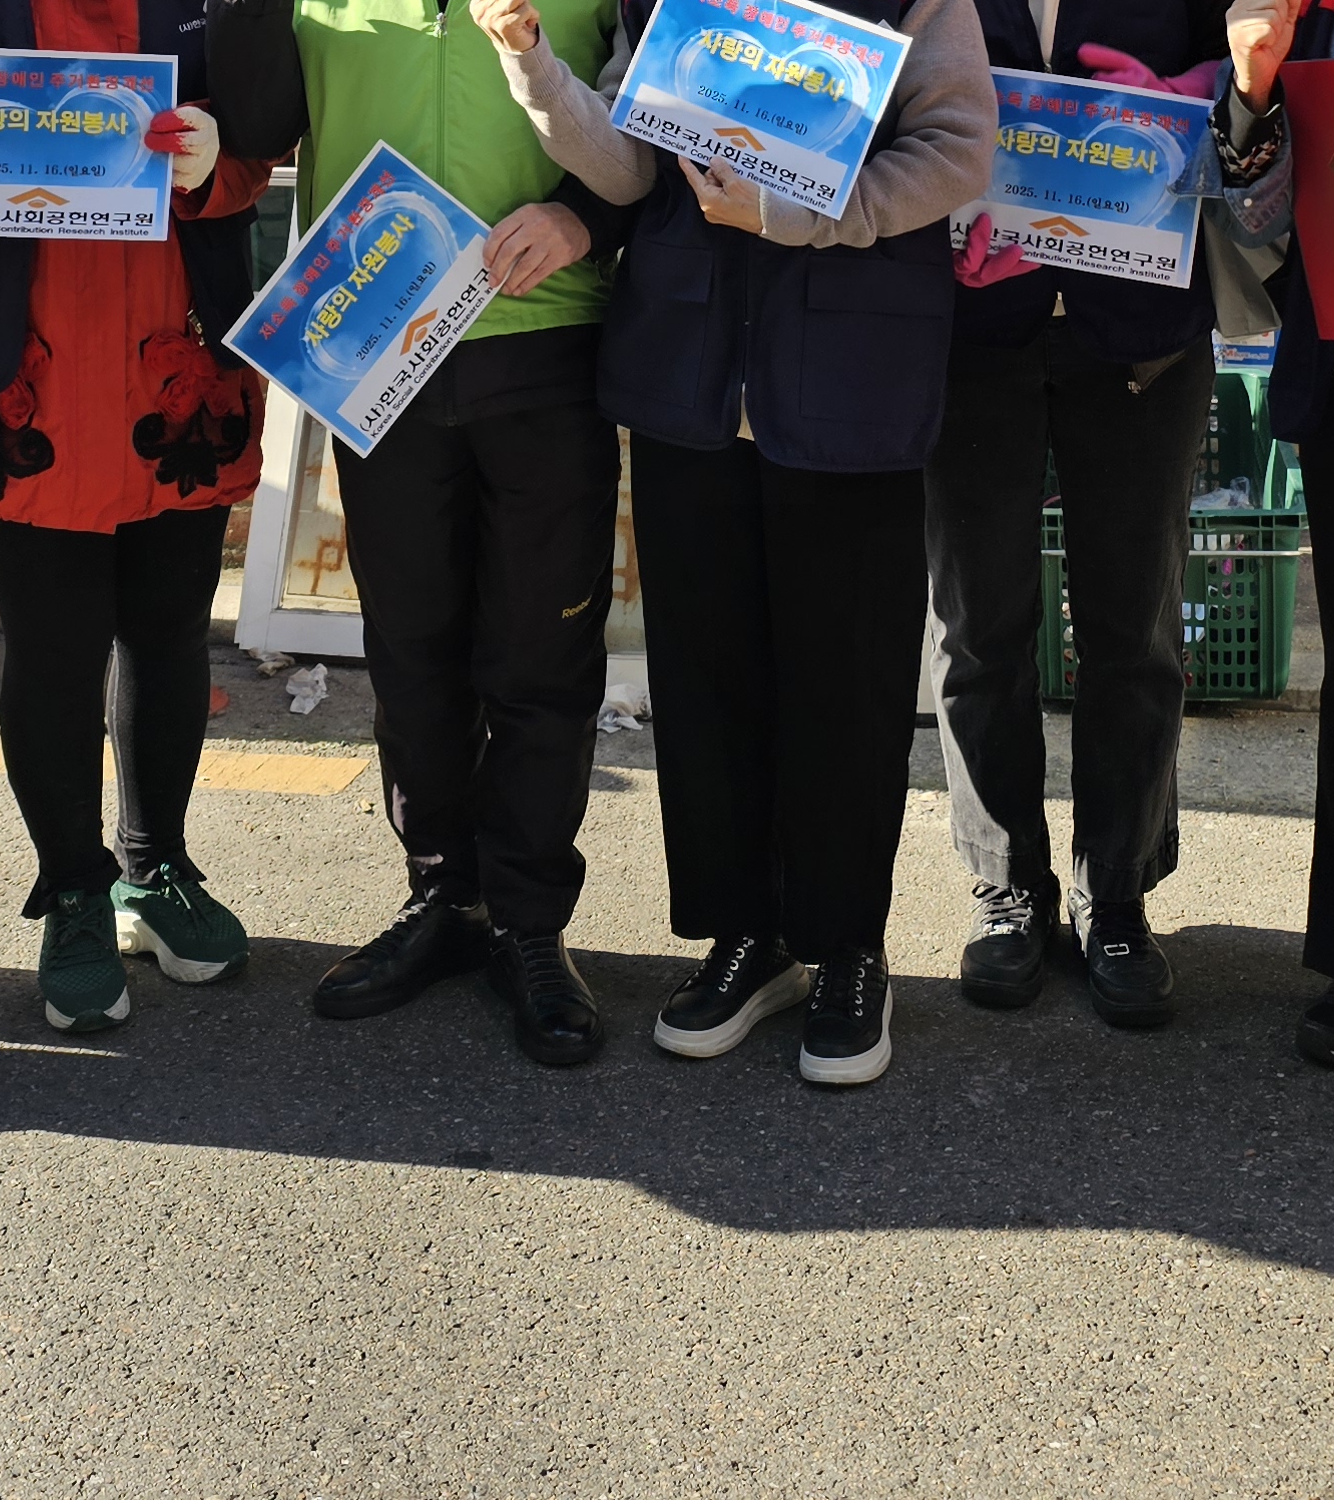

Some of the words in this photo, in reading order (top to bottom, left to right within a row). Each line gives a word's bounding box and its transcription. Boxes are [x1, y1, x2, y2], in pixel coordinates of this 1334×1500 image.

[697, 25, 764, 72] 사랑의
[759, 50, 849, 105] 자원봉사
[34, 108, 128, 136] 자원봉사
[696, 83, 730, 107] 2025.
[731, 98, 751, 115] 11.
[19, 163, 37, 175] 11.
[625, 121, 654, 139] Korea
[657, 134, 687, 152] Social
[745, 171, 789, 194] Research
[790, 189, 827, 210] Institute
[627, 106, 837, 203] (사)한국사회공헌연구원
[994, 125, 1060, 159] 사랑의
[1062, 136, 1159, 175] 자원봉사
[1004, 182, 1039, 199] 2025.
[1043, 189, 1063, 203] 11.
[58, 227, 105, 235] Research
[109, 228, 149, 236] Institute
[300, 284, 359, 350] 사랑의
[344, 210, 417, 295] 자원봉사
[1020, 249, 1072, 264] ontribution
[1076, 258, 1124, 273] Research
[1128, 267, 1171, 281] Institute
[354, 329, 383, 361] 2025.
[378, 310, 397, 331] 11.
[357, 266, 493, 434] (사)한국사회공헌연구
[370, 412, 393, 439] Korea
[391, 384, 415, 412] Social
[413, 335, 454, 384] Contribution
[451, 295, 485, 336] Research
